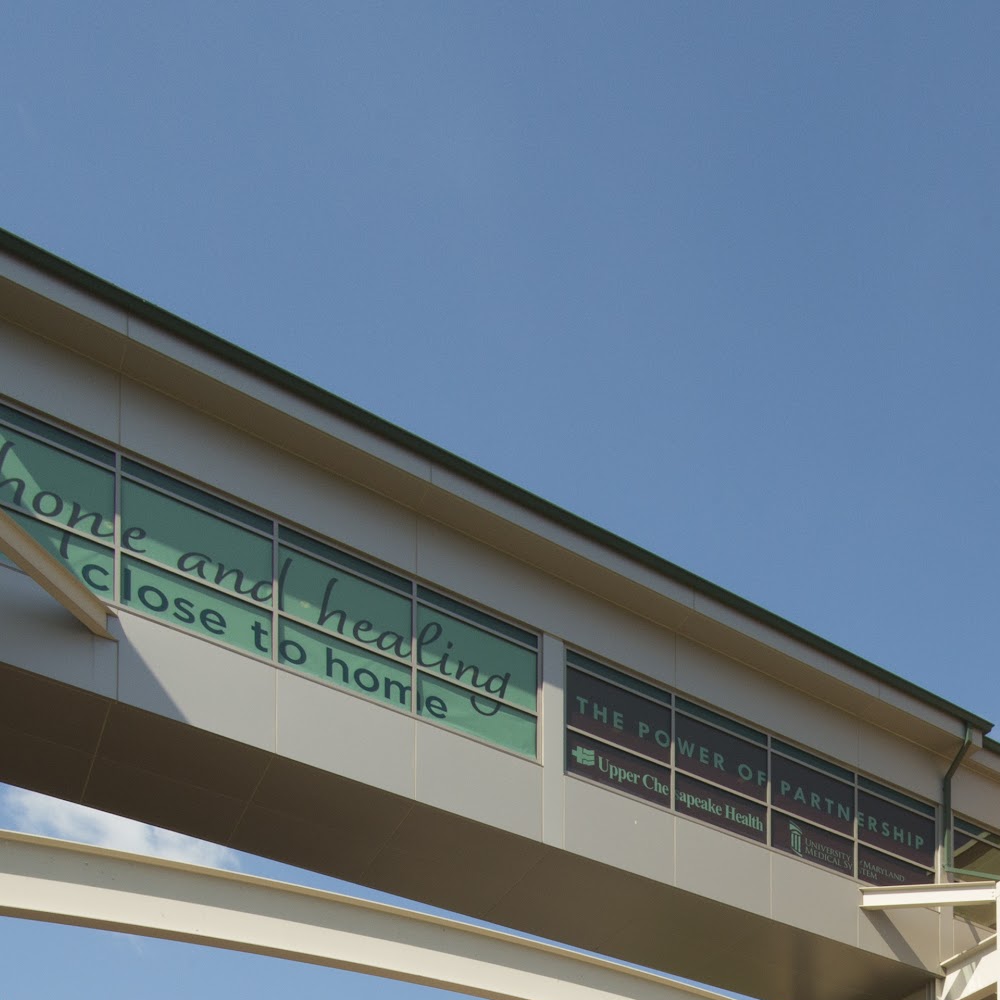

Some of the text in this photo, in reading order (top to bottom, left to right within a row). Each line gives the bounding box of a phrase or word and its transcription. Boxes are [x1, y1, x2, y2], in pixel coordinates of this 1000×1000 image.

[82, 564, 447, 719] close to home
[177, 552, 292, 612] and
[317, 577, 511, 717] healing
[576, 696, 924, 849] THE POWER OF PARTNERSHIP
[598, 756, 640, 784] Upper
[725, 804, 763, 832] Health
[805, 838, 905, 882] UNIVERSITY MARYLAND
[805, 847, 841, 867] MEDICAL
[844, 860, 878, 880] SYTEM
